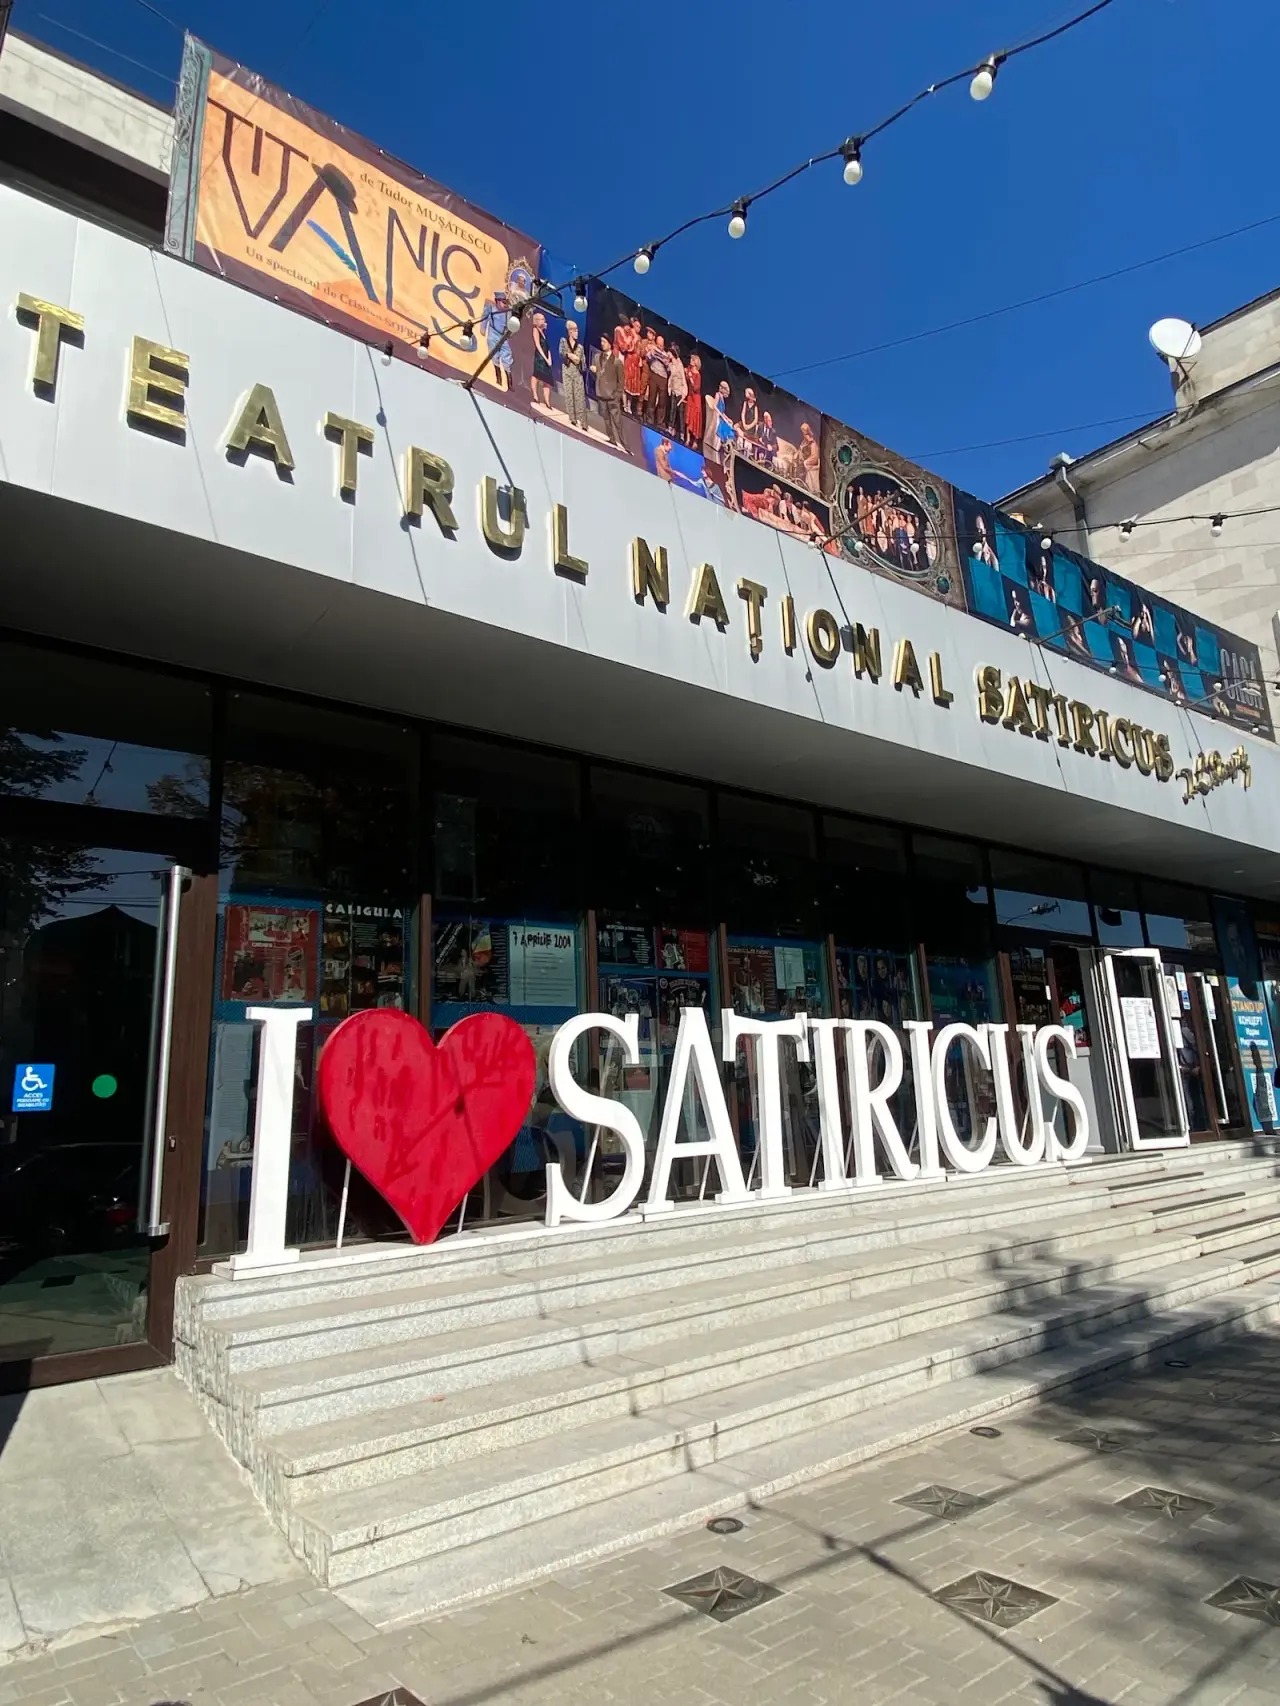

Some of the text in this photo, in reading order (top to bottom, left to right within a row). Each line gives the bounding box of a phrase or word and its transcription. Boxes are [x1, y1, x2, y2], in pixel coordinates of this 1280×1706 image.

[360, 173, 375, 188] de
[379, 181, 413, 207] Tudor
[246, 245, 263, 262] Un
[266, 258, 321, 290] spectacol
[323, 286, 337, 298] de
[15, 291, 589, 584] TEATRUL
[977, 665, 1174, 783] SATIRICUS
[325, 902, 403, 919] CALIGULA
[520, 932, 552, 948] APRILIE
[230, 1006, 313, 1273] I
[543, 1007, 1090, 1226] SATIRICUS
